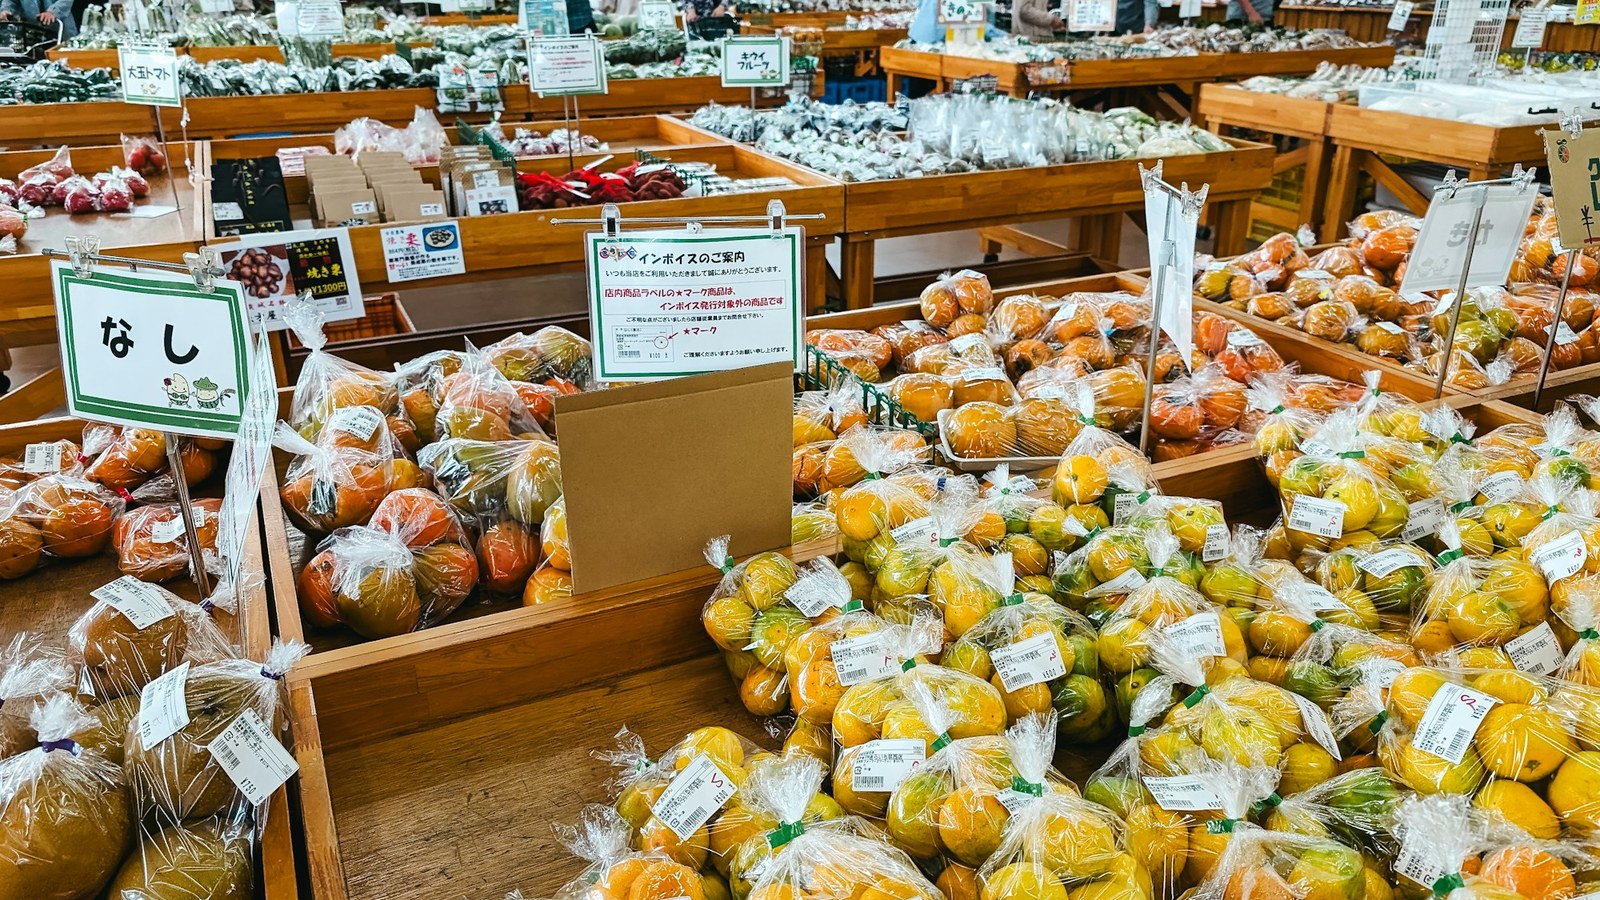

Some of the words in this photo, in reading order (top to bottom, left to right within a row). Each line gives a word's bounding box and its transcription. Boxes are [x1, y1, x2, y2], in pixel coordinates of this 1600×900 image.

[740, 52, 766, 61] キウイ
[128, 64, 171, 81] 大玉トマト
[736, 61, 770, 71] フルーツ
[639, 251, 745, 265] インボイスのご案内
[306, 264, 342, 278] 焼き栗
[606, 266, 782, 278] いつも当店をご利用いただきまして誠にありがとうございます。
[312, 282, 346, 294] ¥1300円
[660, 297, 784, 310] インボイス発行対象外の商品です
[101, 316, 200, 364] なし
[684, 346, 788, 358] ご理解くださいますようお願い申し上げます。
[240, 777, 257, 795] ¥750
[713, 790, 728, 804] ¥500
